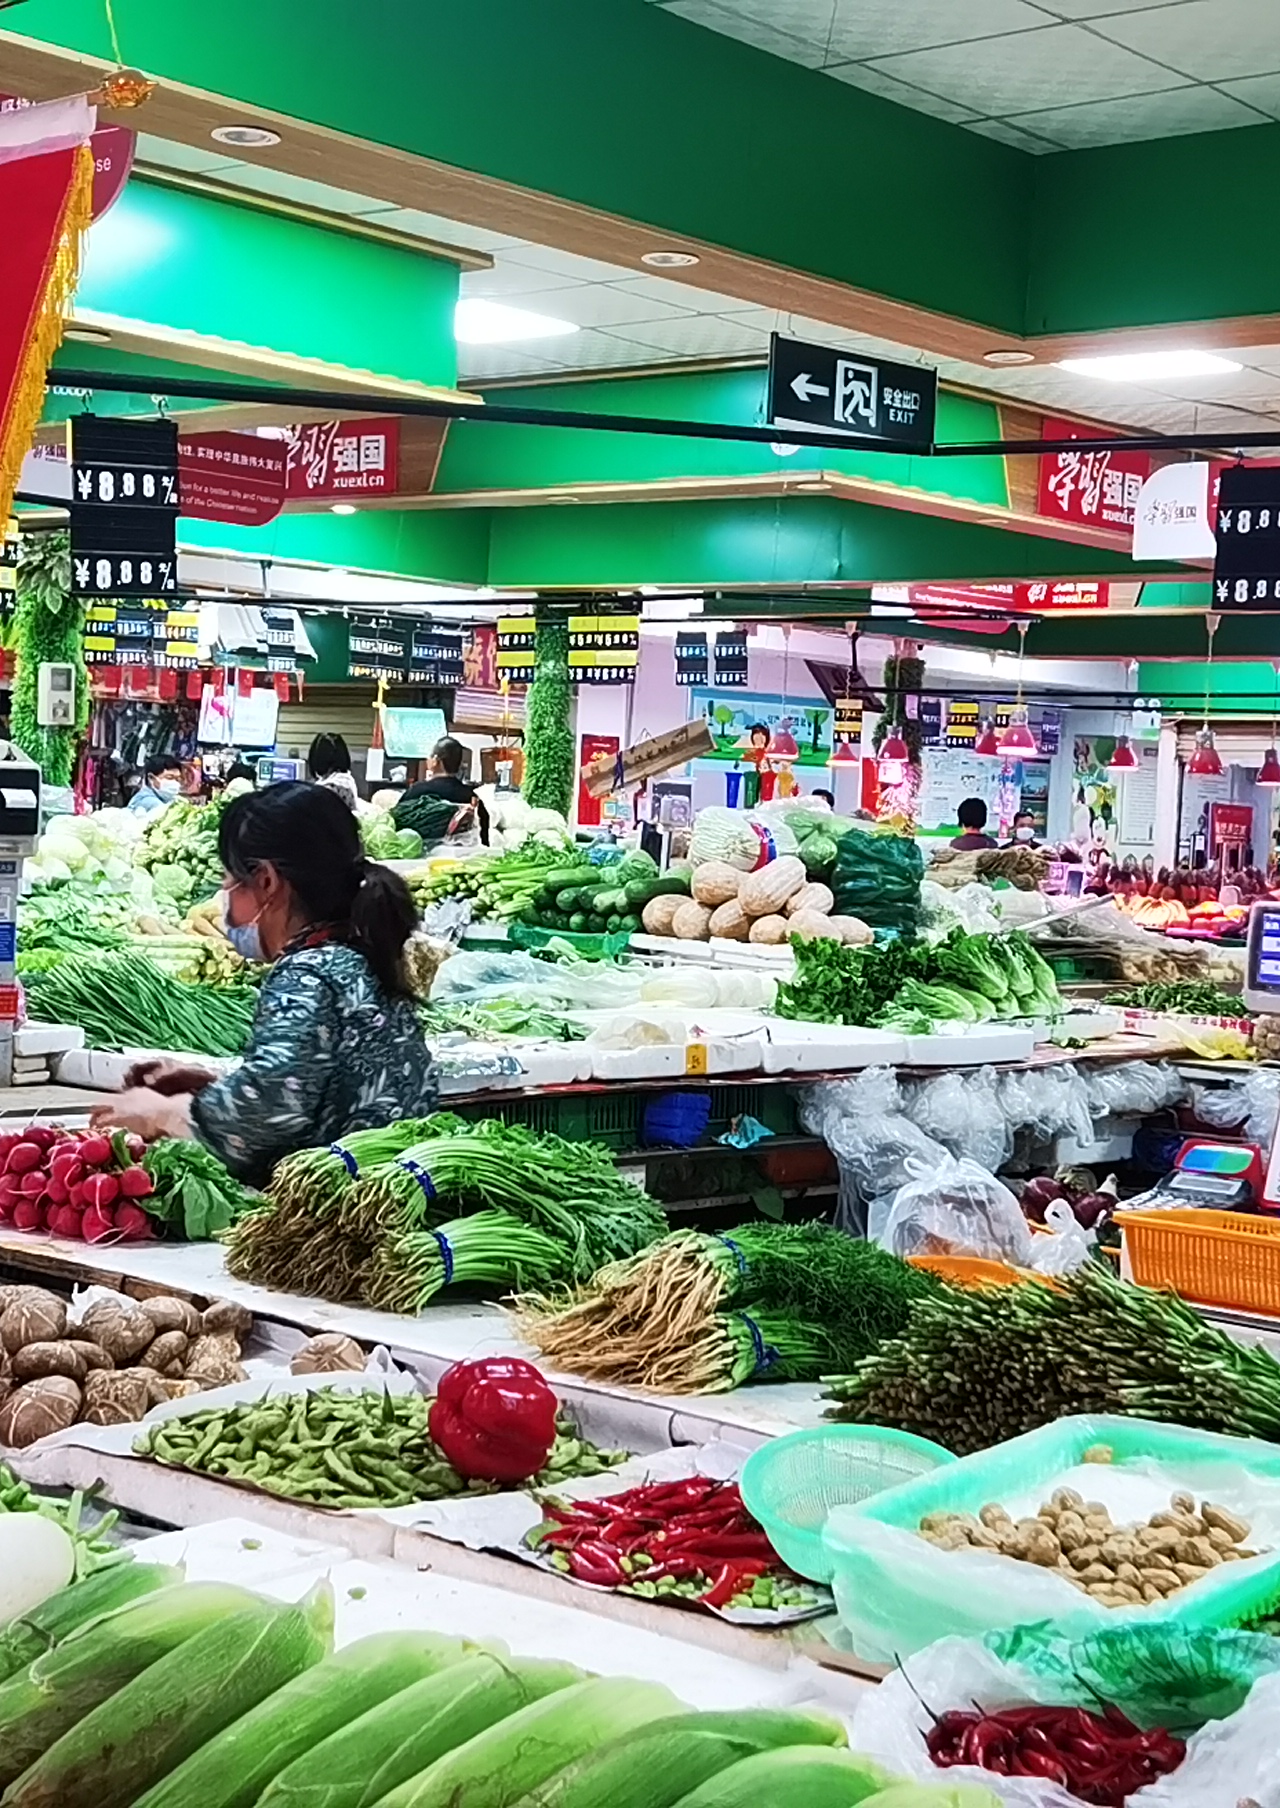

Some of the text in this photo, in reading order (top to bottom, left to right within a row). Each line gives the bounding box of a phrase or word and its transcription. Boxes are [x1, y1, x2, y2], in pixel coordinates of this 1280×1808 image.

[882, 386, 921, 411] 安全出口
[888, 410, 916, 425] EXIT
[1047, 450, 1144, 516] 学习强国
